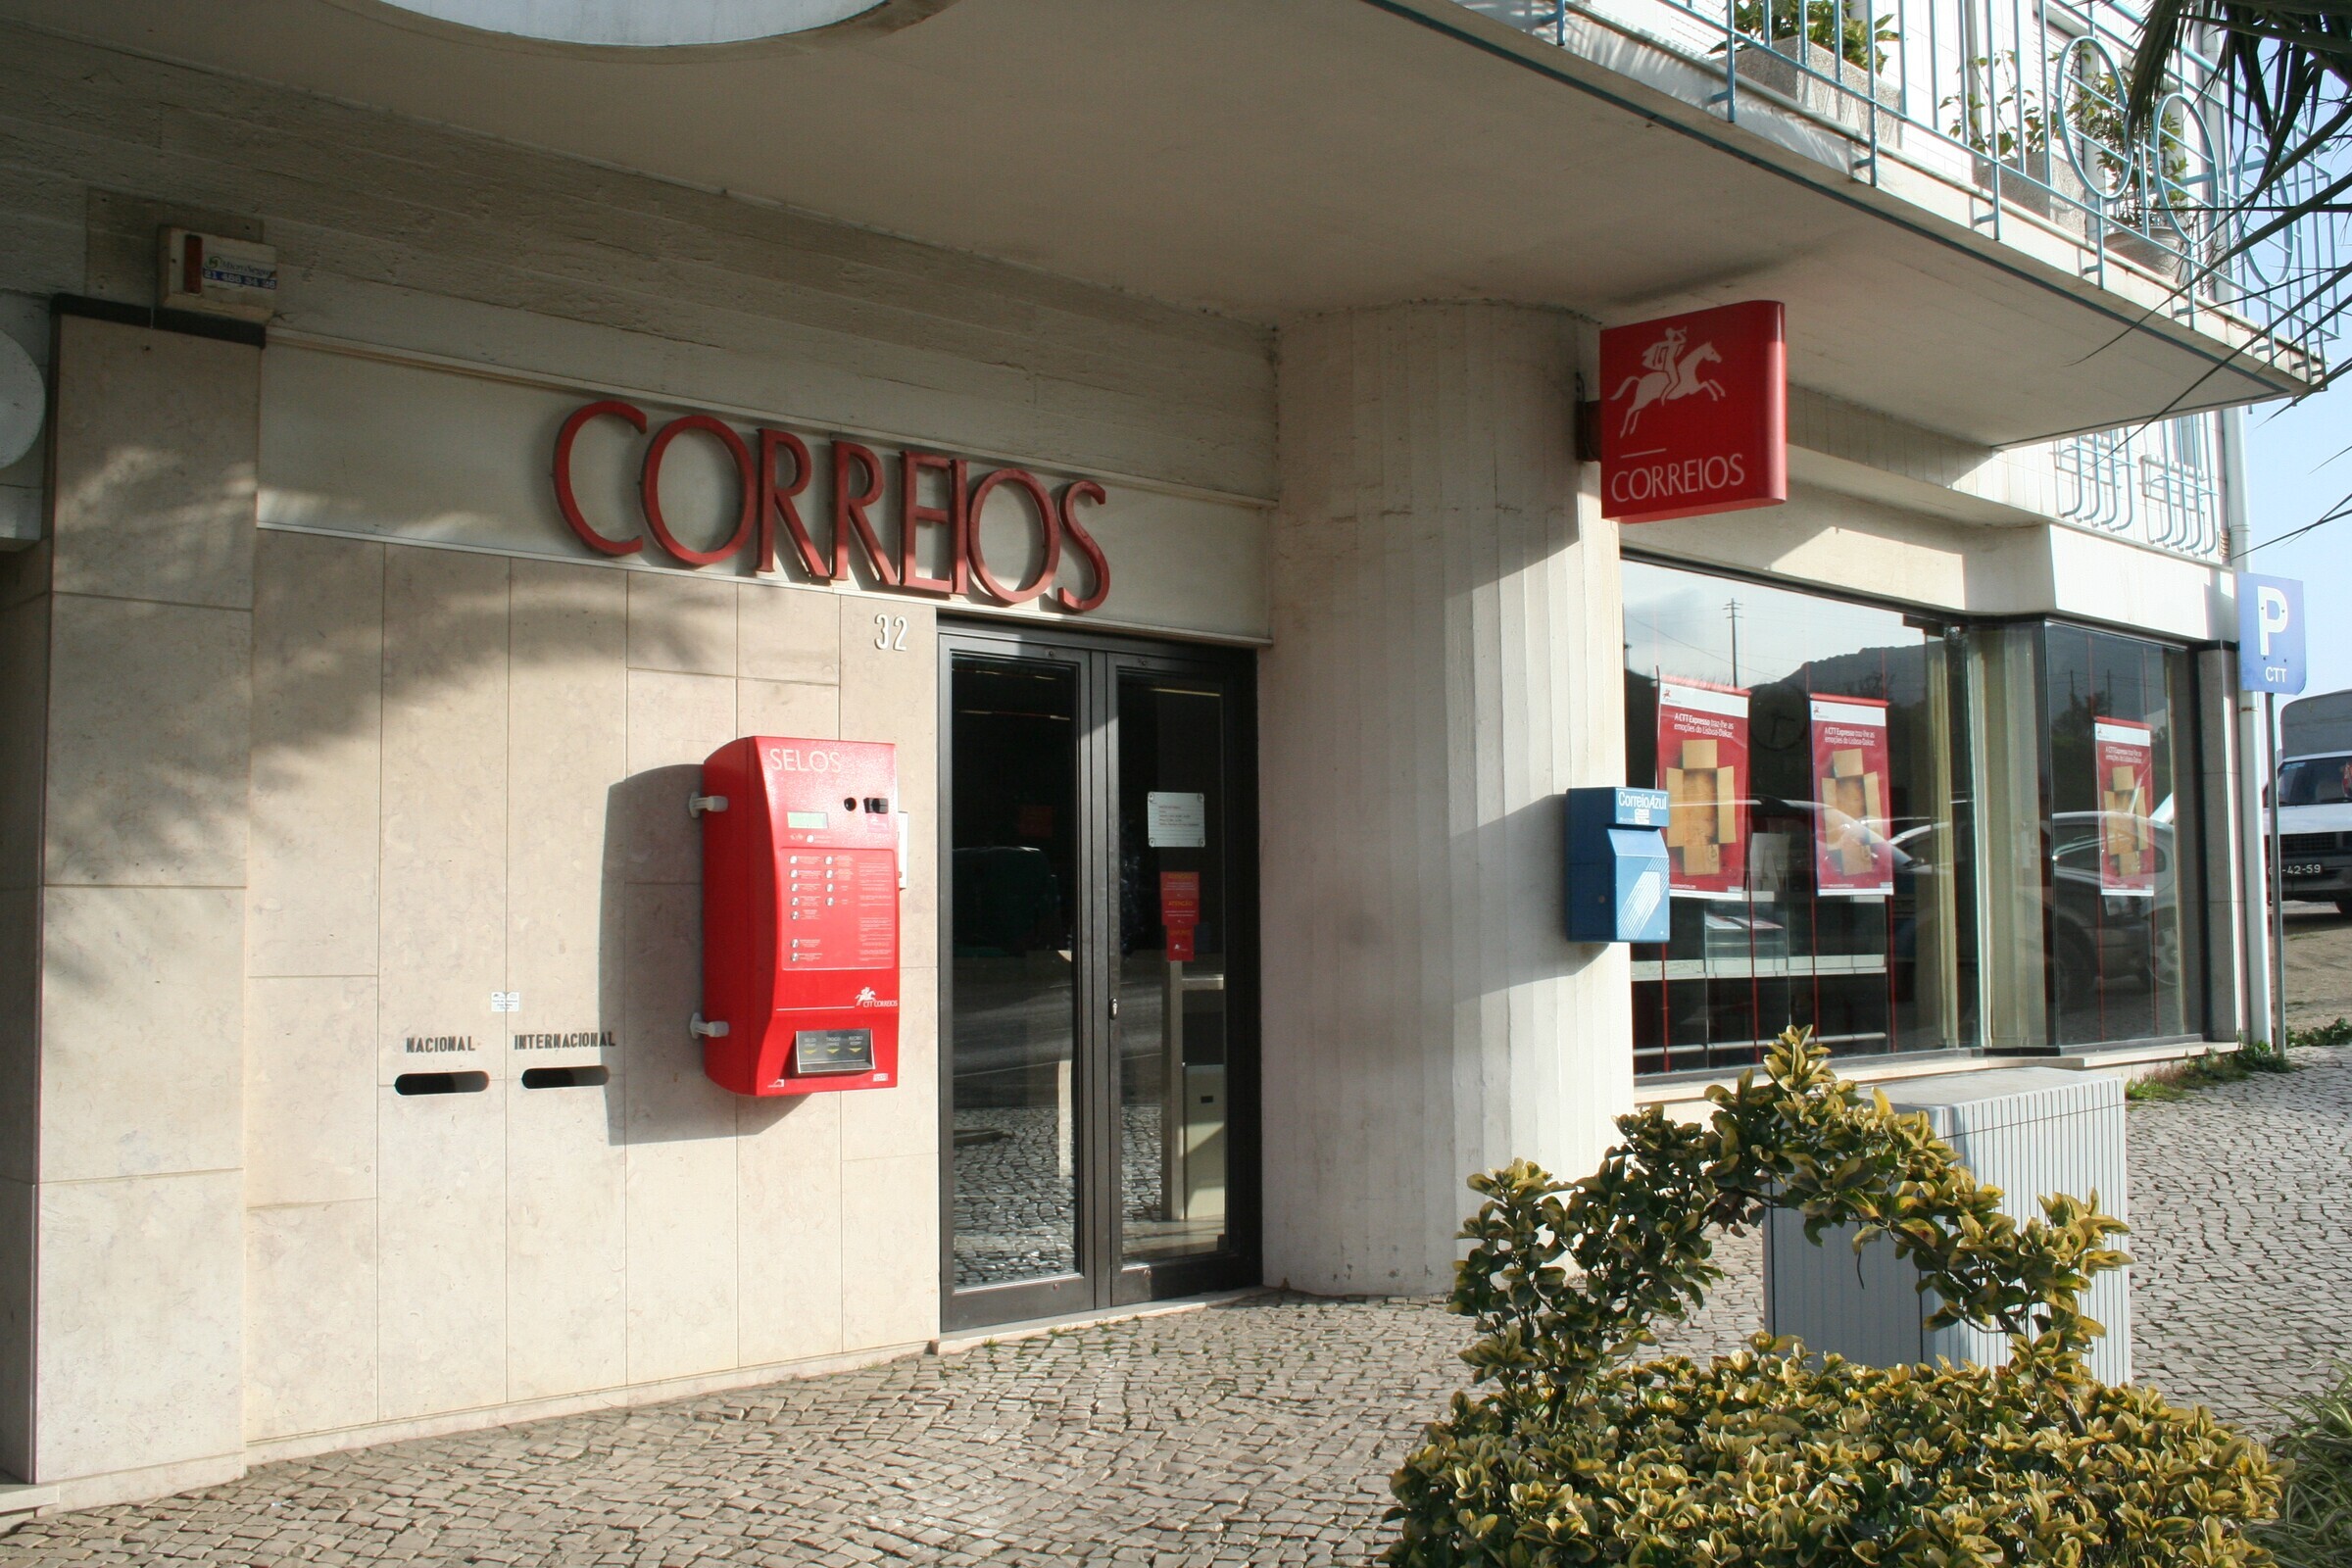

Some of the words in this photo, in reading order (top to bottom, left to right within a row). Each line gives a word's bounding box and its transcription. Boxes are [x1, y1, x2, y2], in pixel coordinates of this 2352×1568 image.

[1611, 454, 1745, 503] CORREIOS
[553, 400, 1110, 612] CORREIOS
[874, 613, 907, 651] 32
[2257, 585, 2288, 656] P
[2265, 666, 2287, 683] CTT
[769, 748, 842, 773] SELOS
[406, 1035, 476, 1054] NACIONAL
[514, 1031, 616, 1051] INTERNACIONAL
